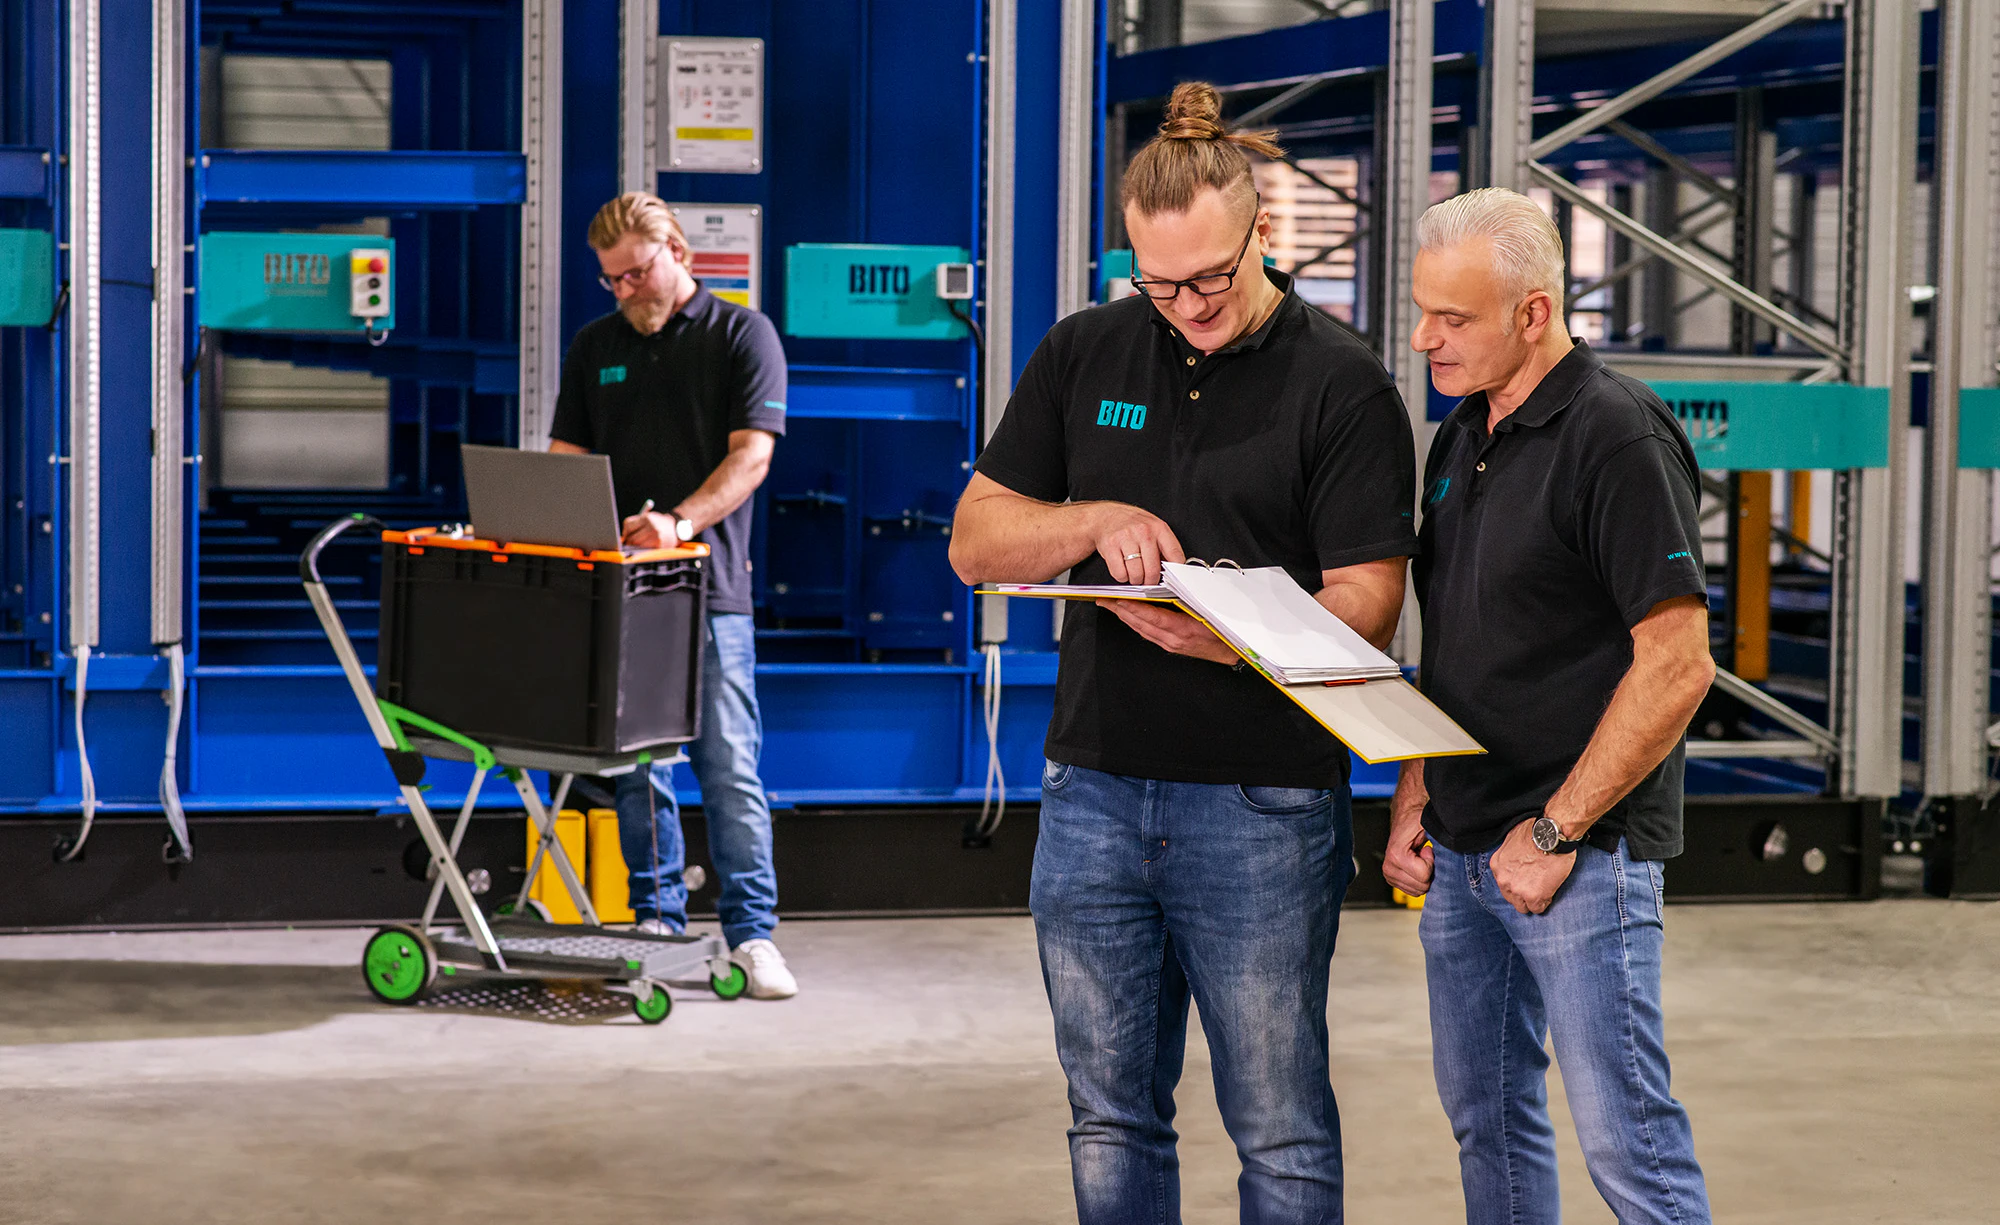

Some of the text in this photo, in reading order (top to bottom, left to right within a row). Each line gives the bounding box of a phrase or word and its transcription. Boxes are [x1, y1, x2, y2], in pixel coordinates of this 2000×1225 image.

[264, 253, 330, 284] BITO
[850, 264, 909, 293] BITO
[1096, 399, 1148, 430] BITO
[1665, 400, 1729, 439] ITO
